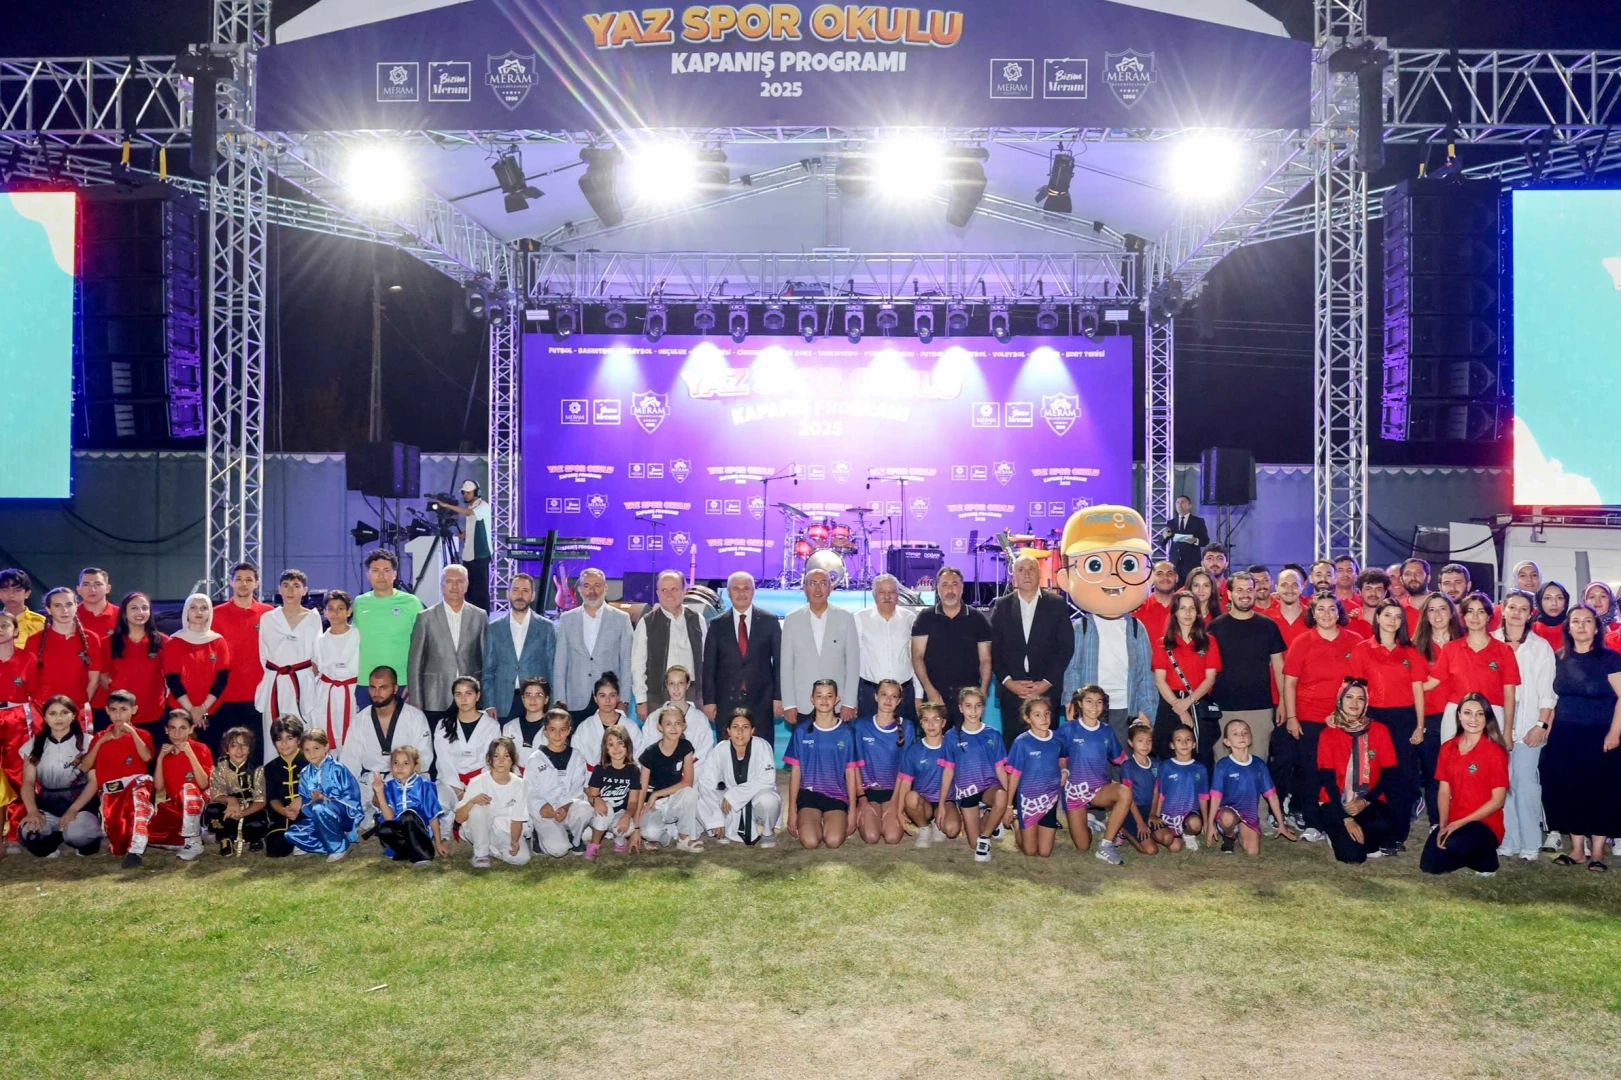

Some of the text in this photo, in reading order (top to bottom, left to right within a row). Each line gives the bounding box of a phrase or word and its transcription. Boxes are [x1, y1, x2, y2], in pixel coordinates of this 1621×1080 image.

[583, 4, 964, 48] YAZ SPOR OKULU
[671, 51, 907, 78] KAPANIŞ PROGRAMI
[489, 74, 532, 84] MERAM
[1107, 72, 1150, 81] MERAM
[384, 87, 413, 95] MERAM
[432, 84, 468, 94] Meram
[760, 82, 803, 97] 2025
[997, 84, 1028, 92] MERAM
[1047, 81, 1084, 92] Meram
[634, 406, 666, 414] MERAM
[1045, 409, 1076, 417] MERAM
